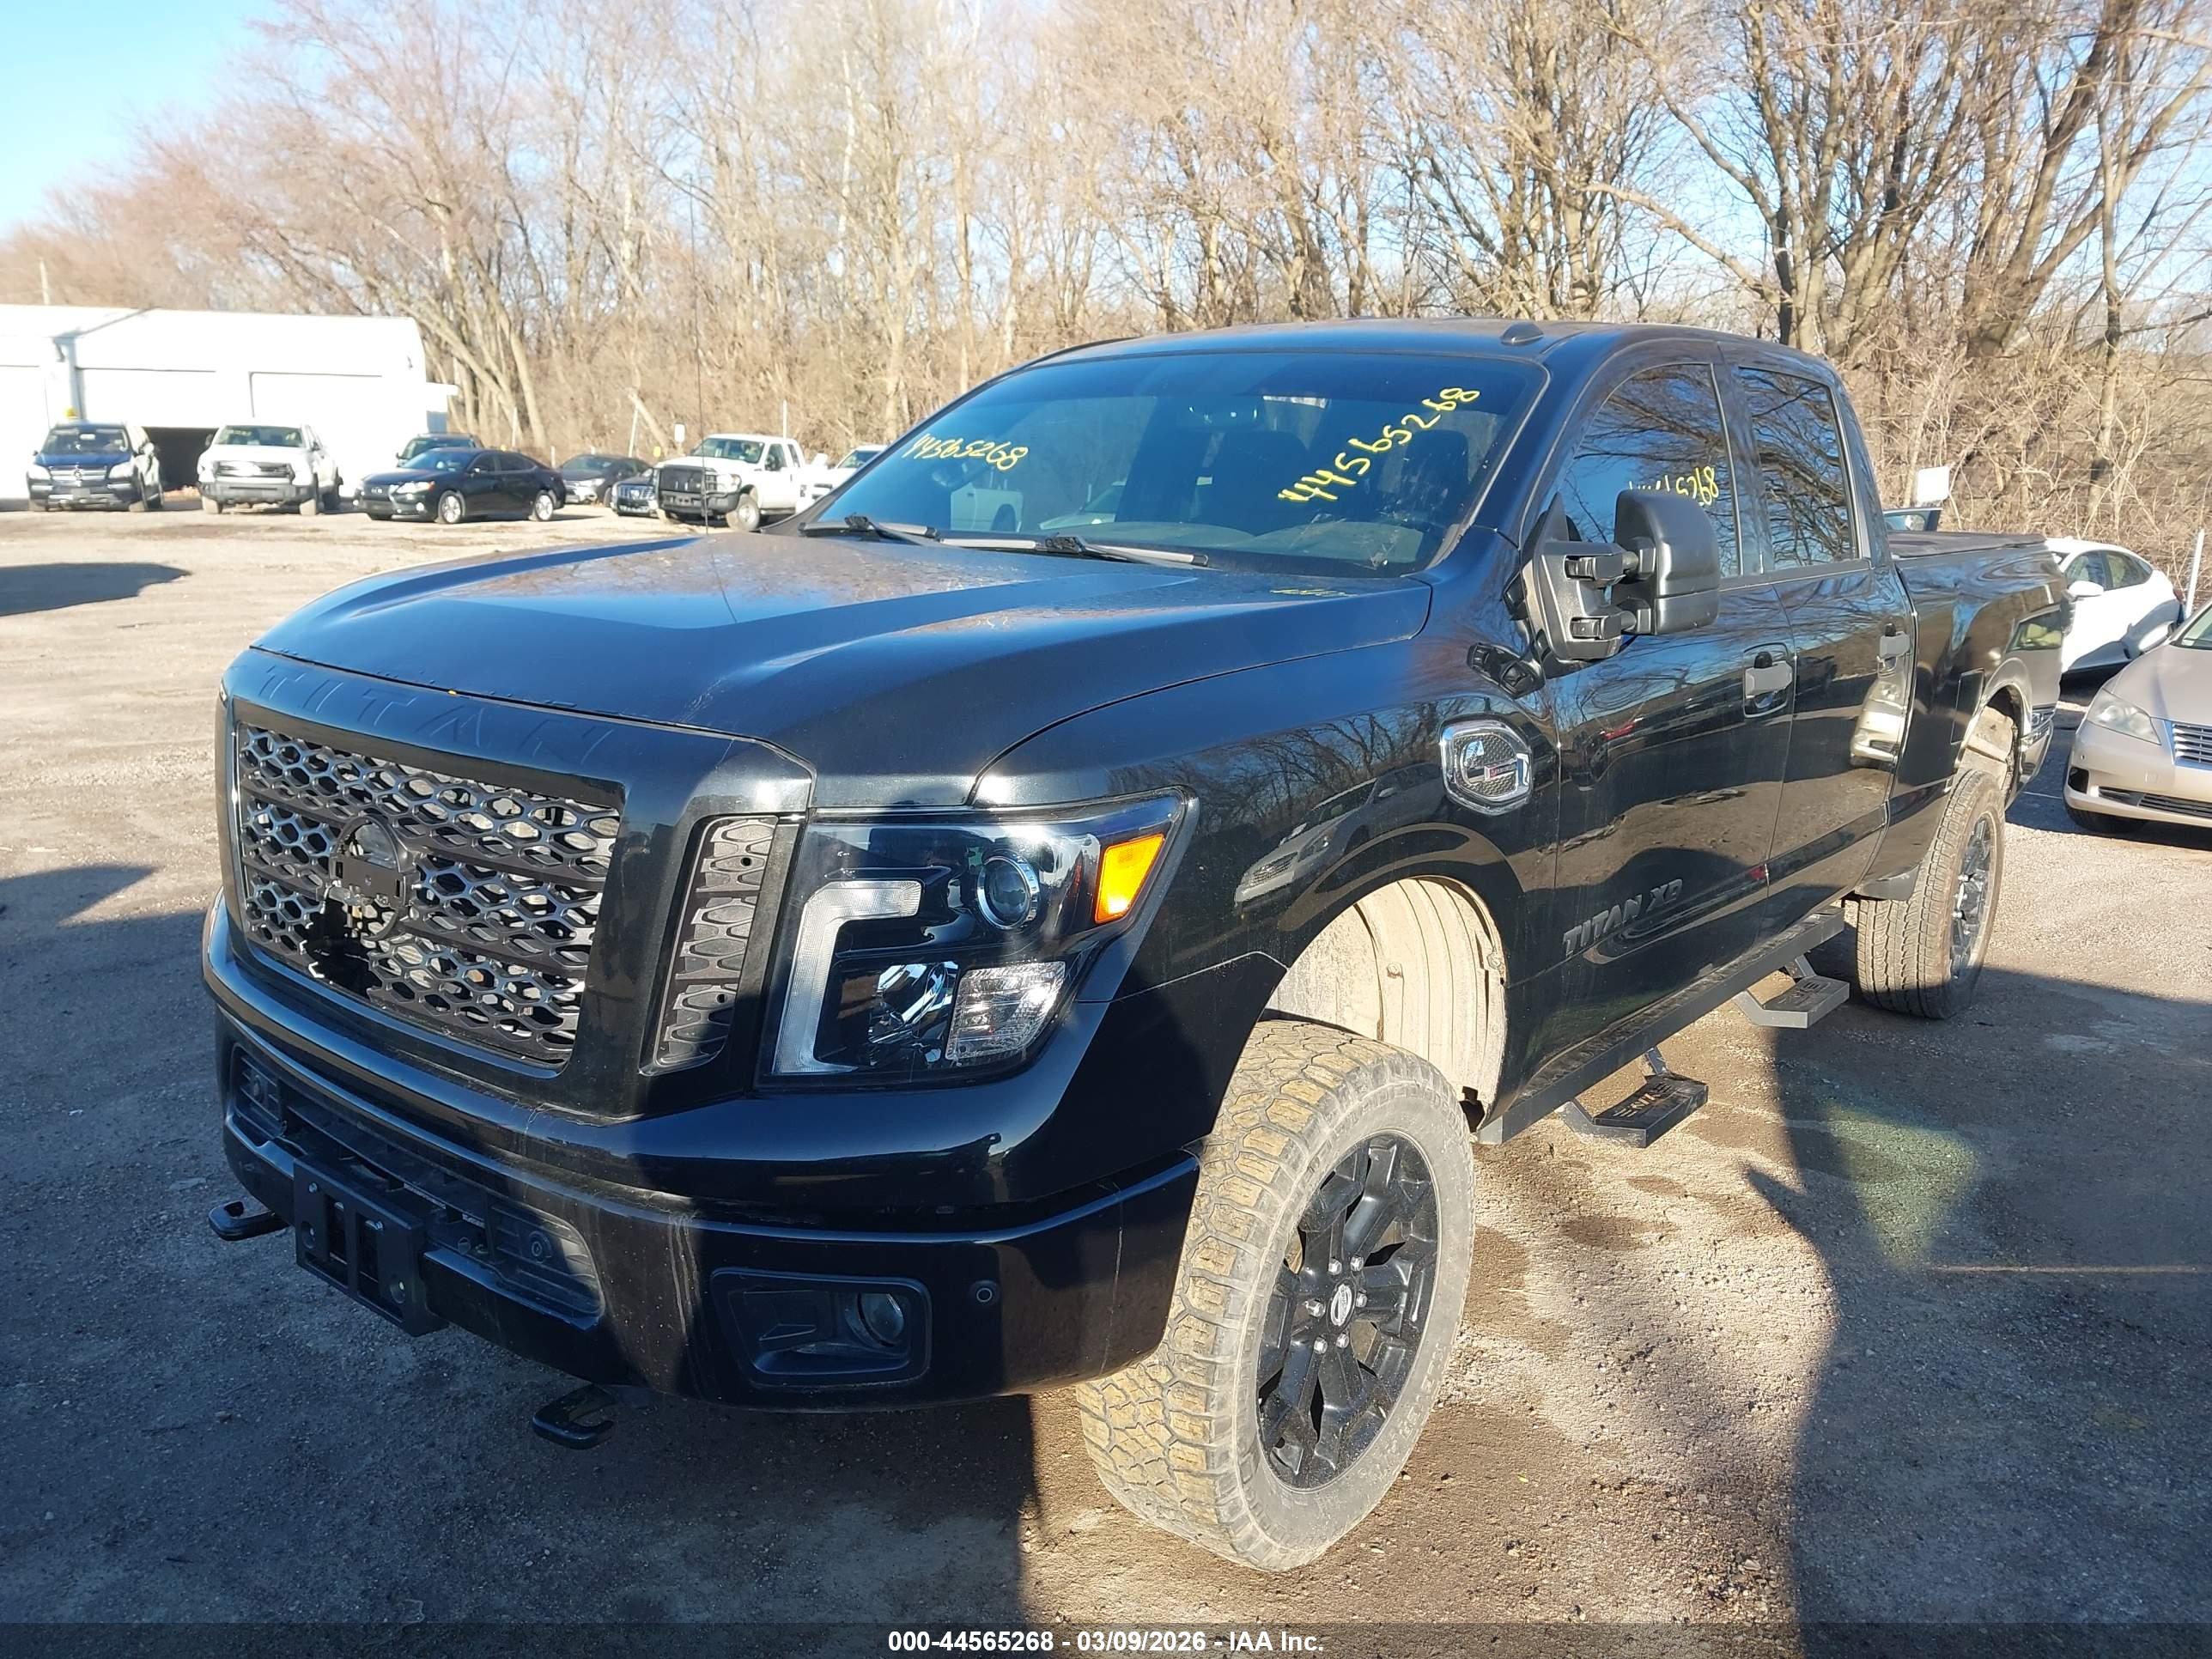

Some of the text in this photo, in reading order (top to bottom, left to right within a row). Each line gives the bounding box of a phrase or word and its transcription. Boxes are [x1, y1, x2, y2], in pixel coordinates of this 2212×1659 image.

[902, 433, 1029, 471] 44565268
[1278, 387, 1481, 502] 44565268
[258, 665, 617, 766] TITAN
[1562, 878, 1684, 958] TITAN XD
